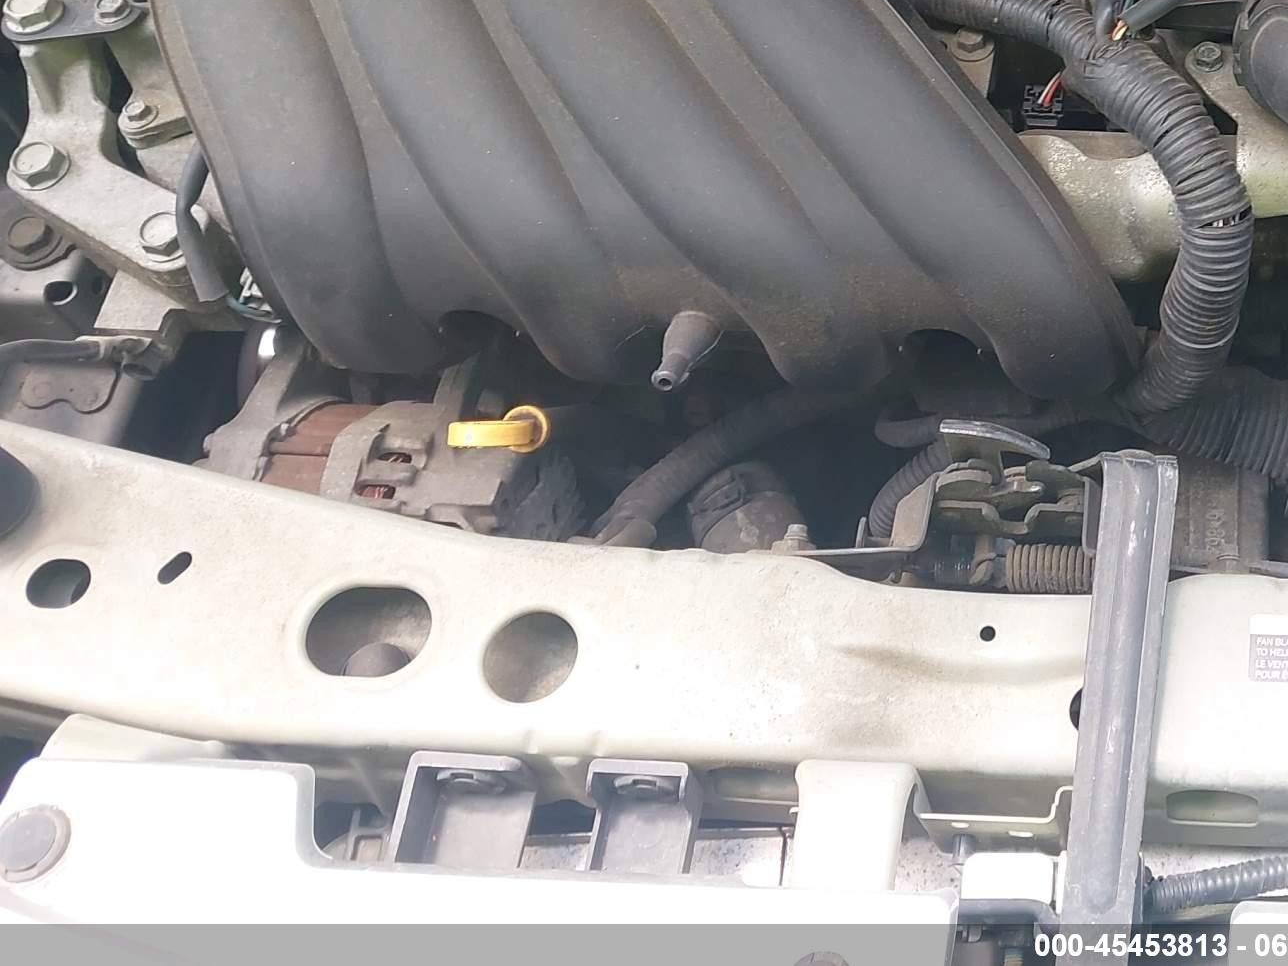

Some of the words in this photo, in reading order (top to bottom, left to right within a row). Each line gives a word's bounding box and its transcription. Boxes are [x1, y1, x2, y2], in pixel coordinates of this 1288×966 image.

[1256, 636, 1273, 646] FAN
[1256, 647, 1268, 656] TO
[1255, 659, 1267, 668] LE
[1255, 670, 1281, 680] POUR
